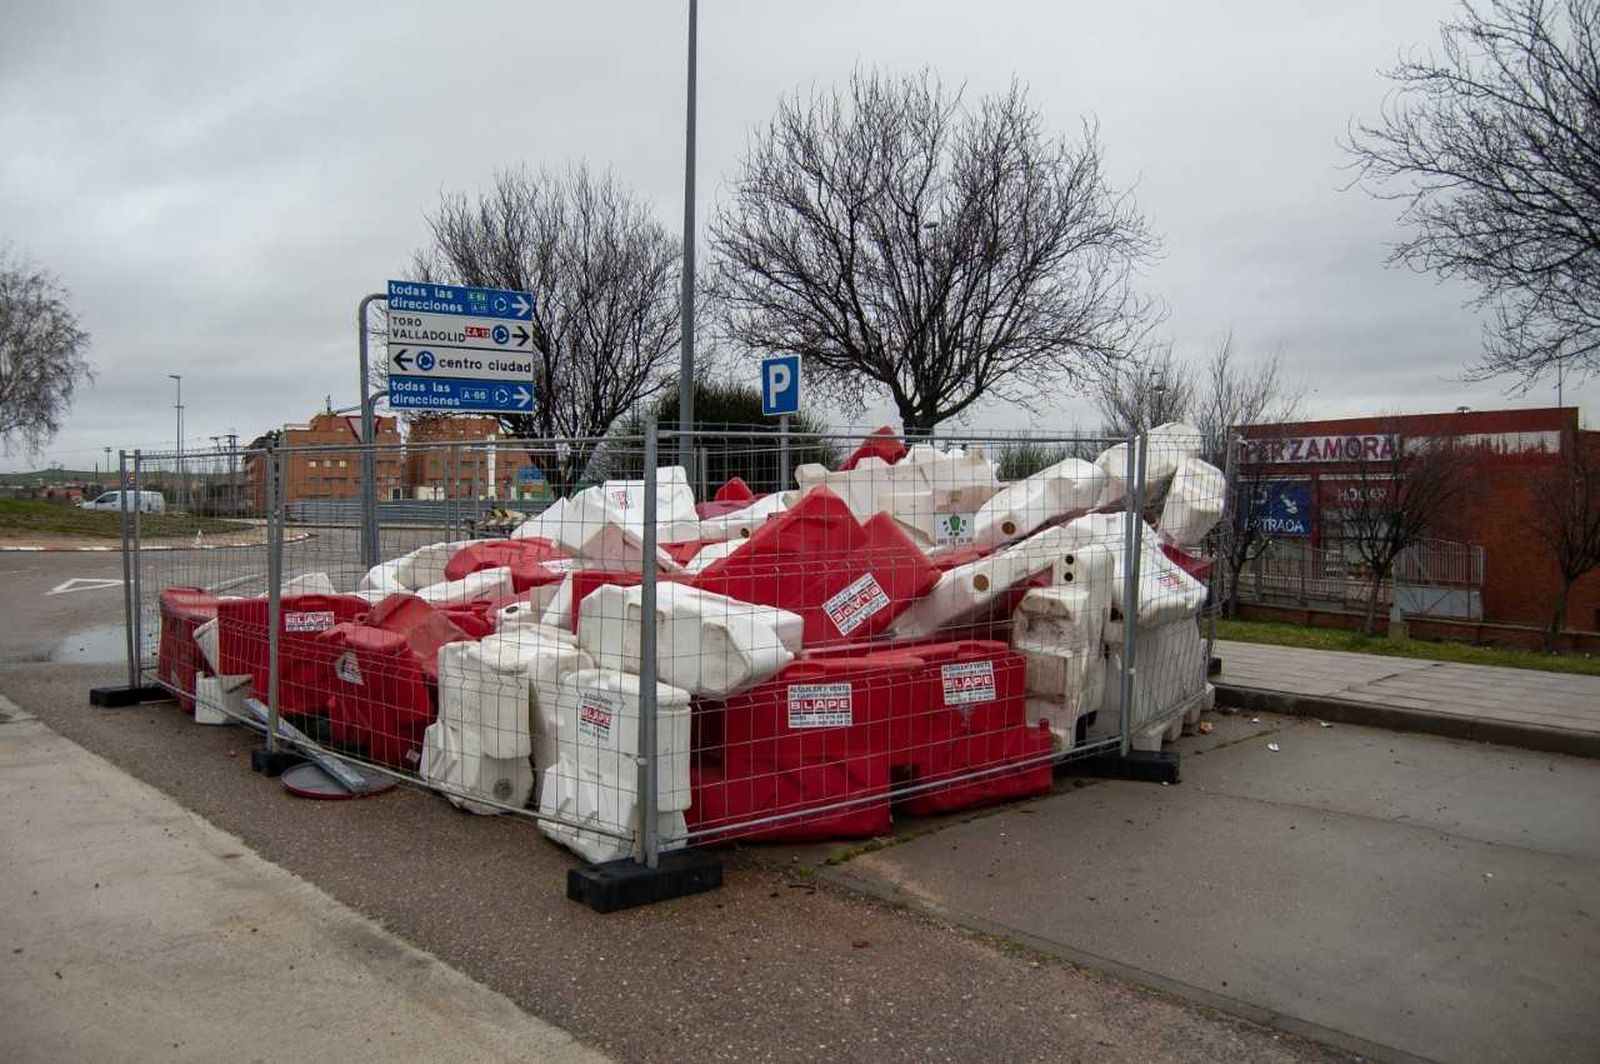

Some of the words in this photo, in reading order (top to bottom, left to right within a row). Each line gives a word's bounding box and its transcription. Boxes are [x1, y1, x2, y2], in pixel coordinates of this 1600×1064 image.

[390, 283, 427, 298] todas
[434, 288, 453, 299] las
[390, 297, 463, 313] direcciones
[392, 317, 422, 327] TORO
[392, 328, 466, 343] VALLADOLID
[439, 358, 482, 370] centro
[488, 359, 531, 373] ciudad
[391, 380, 425, 392] todas
[433, 382, 450, 393] las
[769, 364, 790, 408] P
[391, 394, 460, 407] direcciones
[790, 699, 850, 711] BLAPE
